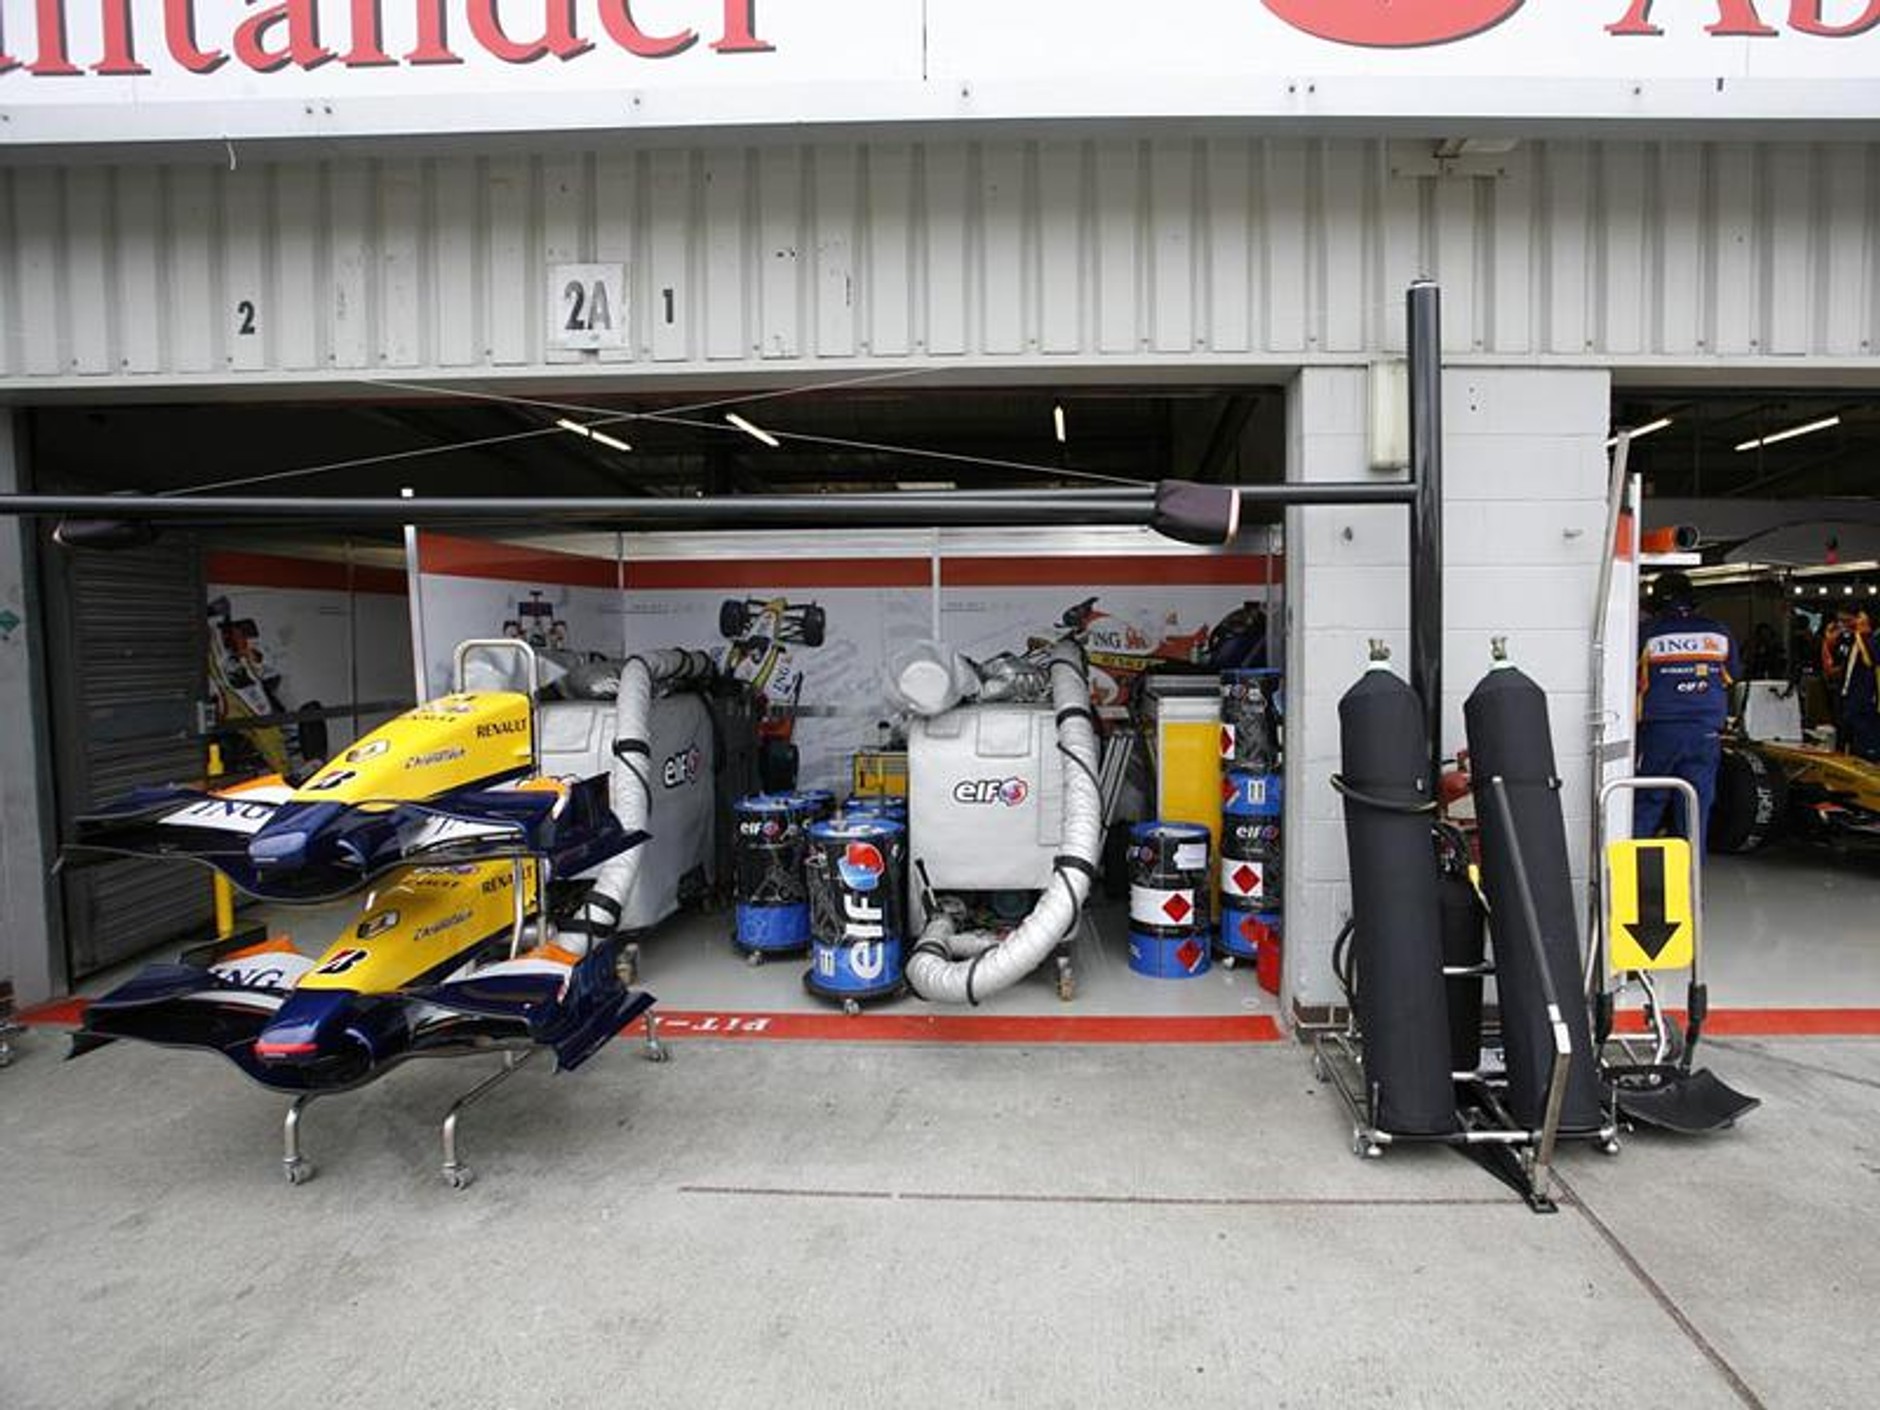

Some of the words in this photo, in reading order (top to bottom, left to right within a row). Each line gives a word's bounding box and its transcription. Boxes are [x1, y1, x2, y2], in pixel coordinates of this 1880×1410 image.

[0, 0, 777, 76] ntaner
[237, 300, 256, 335] 2
[564, 280, 612, 330] 2A
[662, 288, 674, 324] 1
[1658, 639, 1698, 652] ING
[476, 719, 528, 738] RENAULT
[664, 754, 688, 787] elf
[955, 781, 1001, 802] elf
[740, 820, 766, 834] elf
[1236, 825, 1261, 838] elf
[481, 864, 534, 895] RENALT
[843, 894, 884, 980] elf
[639, 1016, 772, 1031] PIT-
